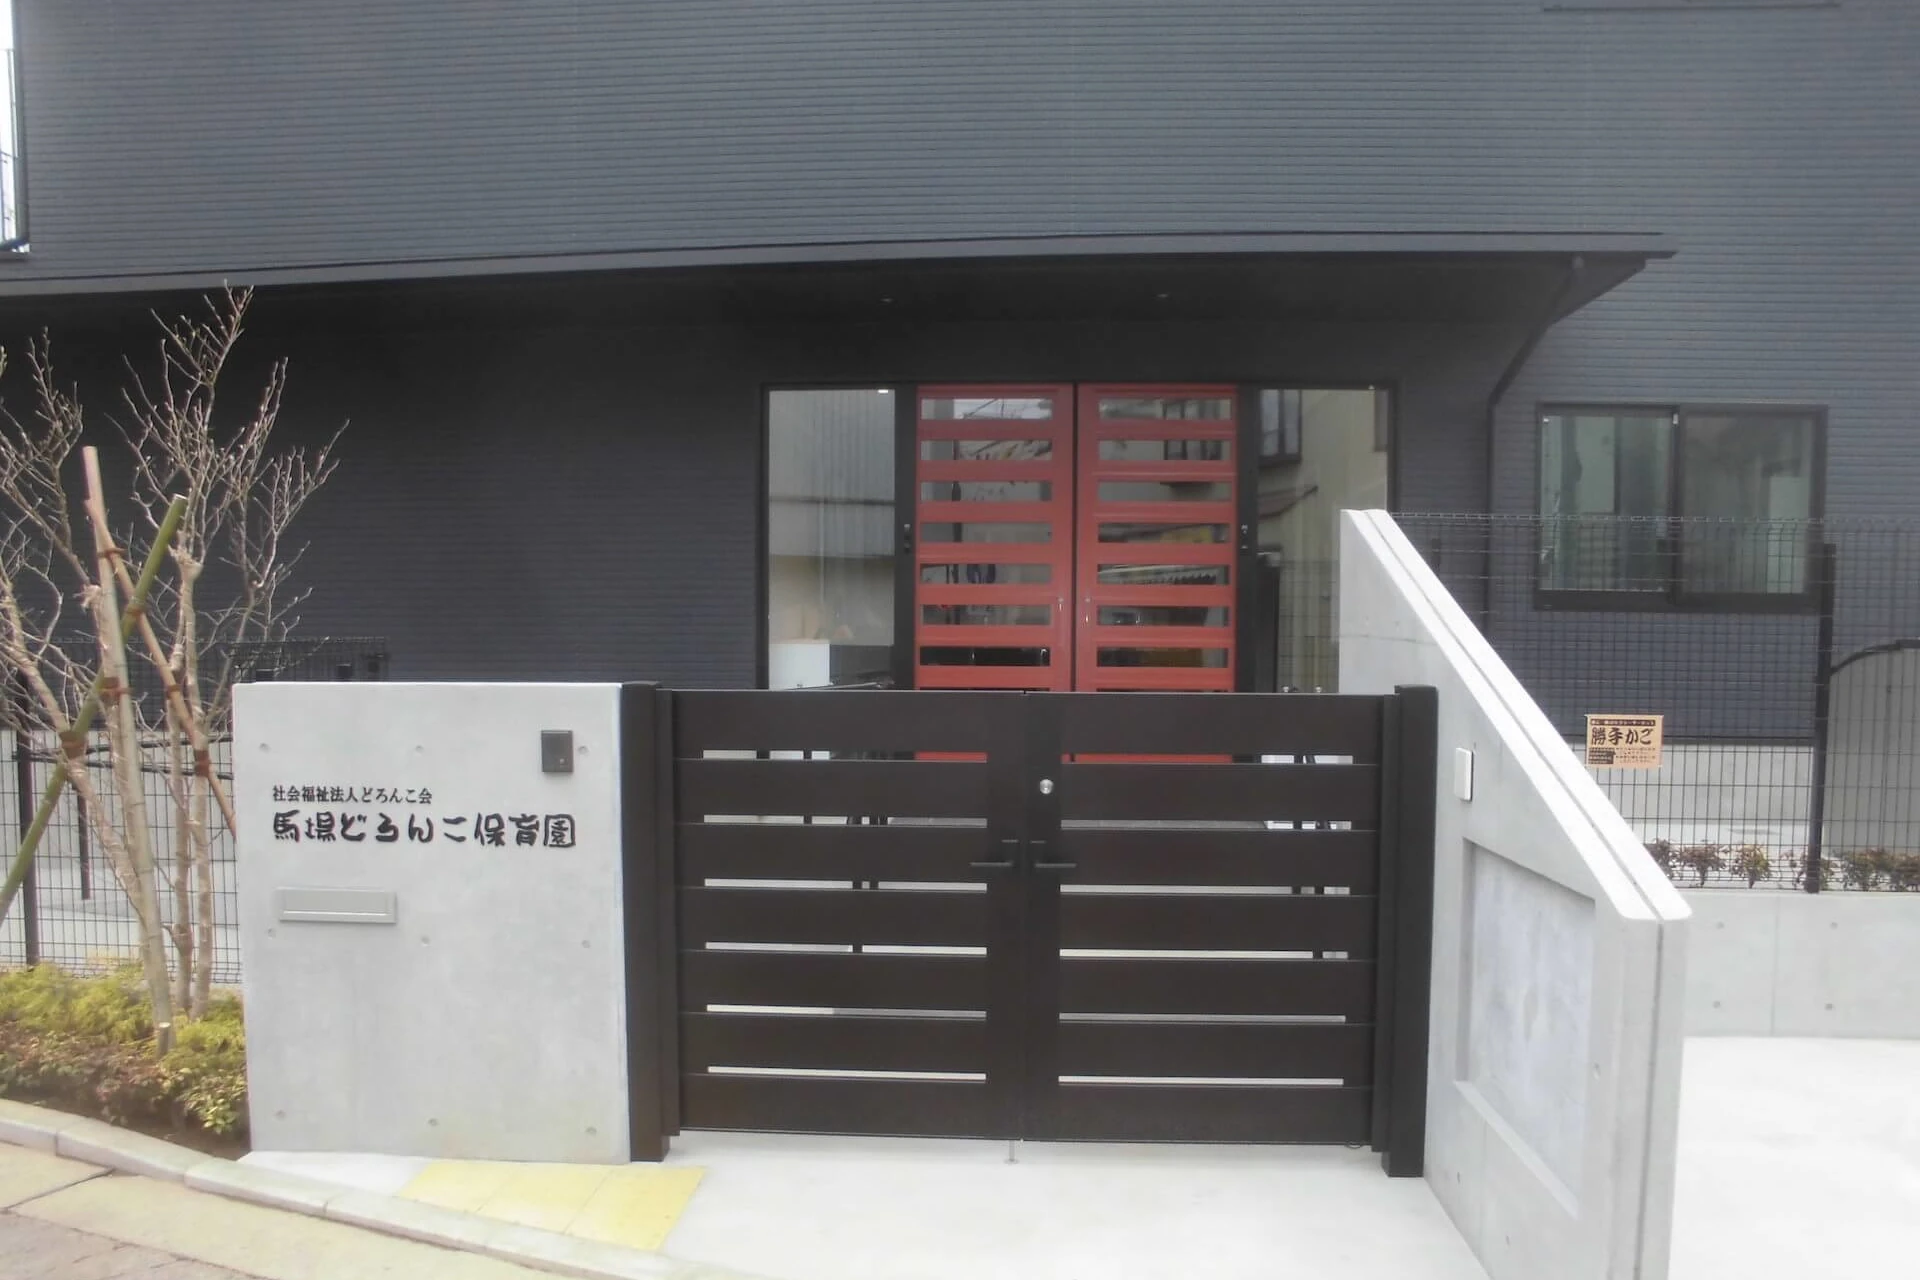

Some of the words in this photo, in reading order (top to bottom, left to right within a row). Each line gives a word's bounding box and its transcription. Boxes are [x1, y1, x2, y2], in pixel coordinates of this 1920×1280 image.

[272, 785, 432, 804] 社会福祉法人どろんこ会
[273, 809, 576, 848] 馬場どろんこ保育園
